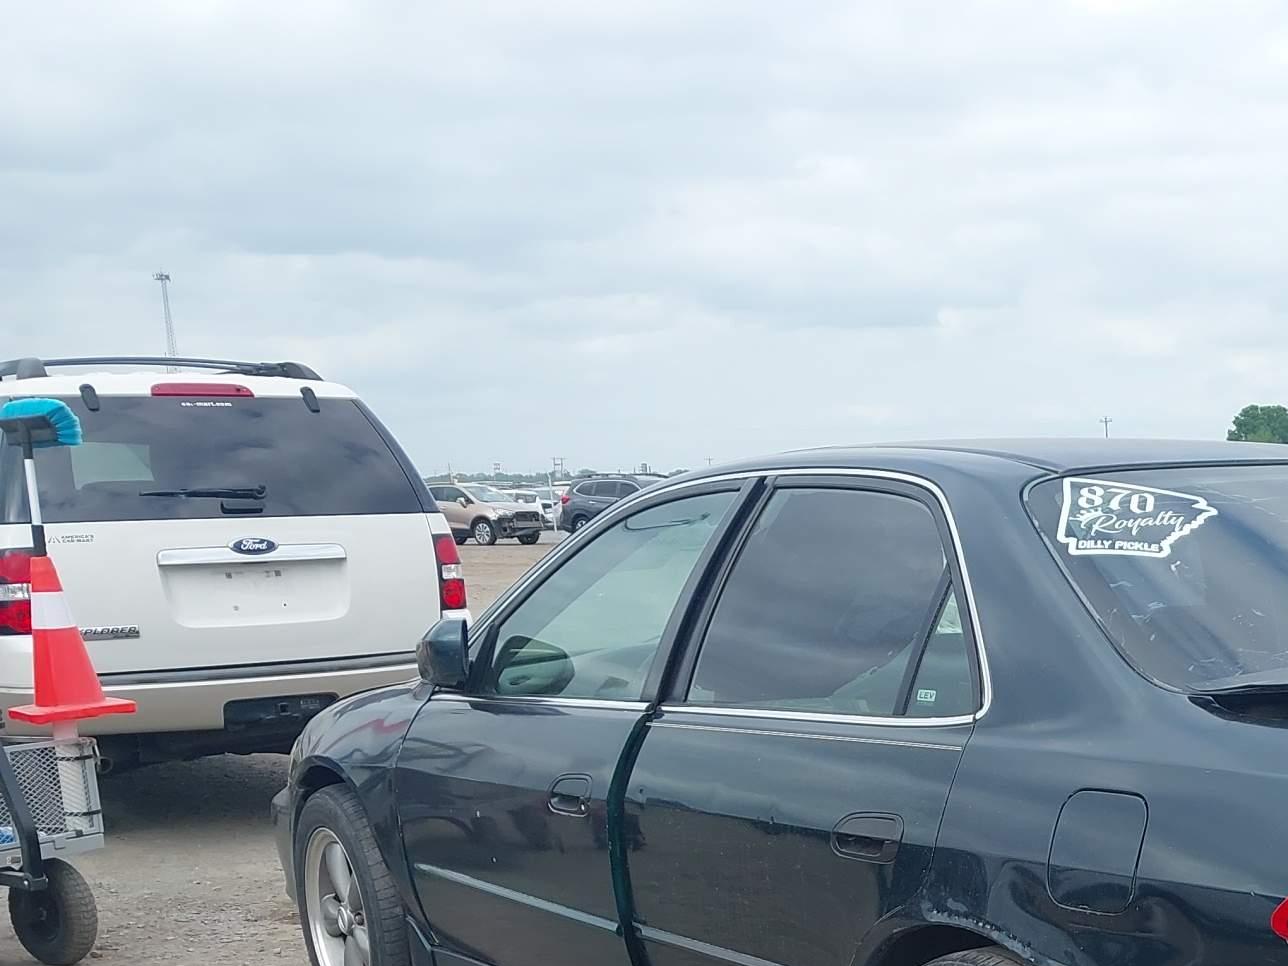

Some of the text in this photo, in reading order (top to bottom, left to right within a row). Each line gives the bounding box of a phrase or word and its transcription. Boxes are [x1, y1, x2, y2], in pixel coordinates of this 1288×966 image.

[1078, 486, 1154, 513] 870
[1081, 510, 1184, 536] Royalty
[241, 539, 268, 550] Ford
[1078, 540, 1160, 552] DILLY PICKLE
[80, 626, 137, 635] PLORER
